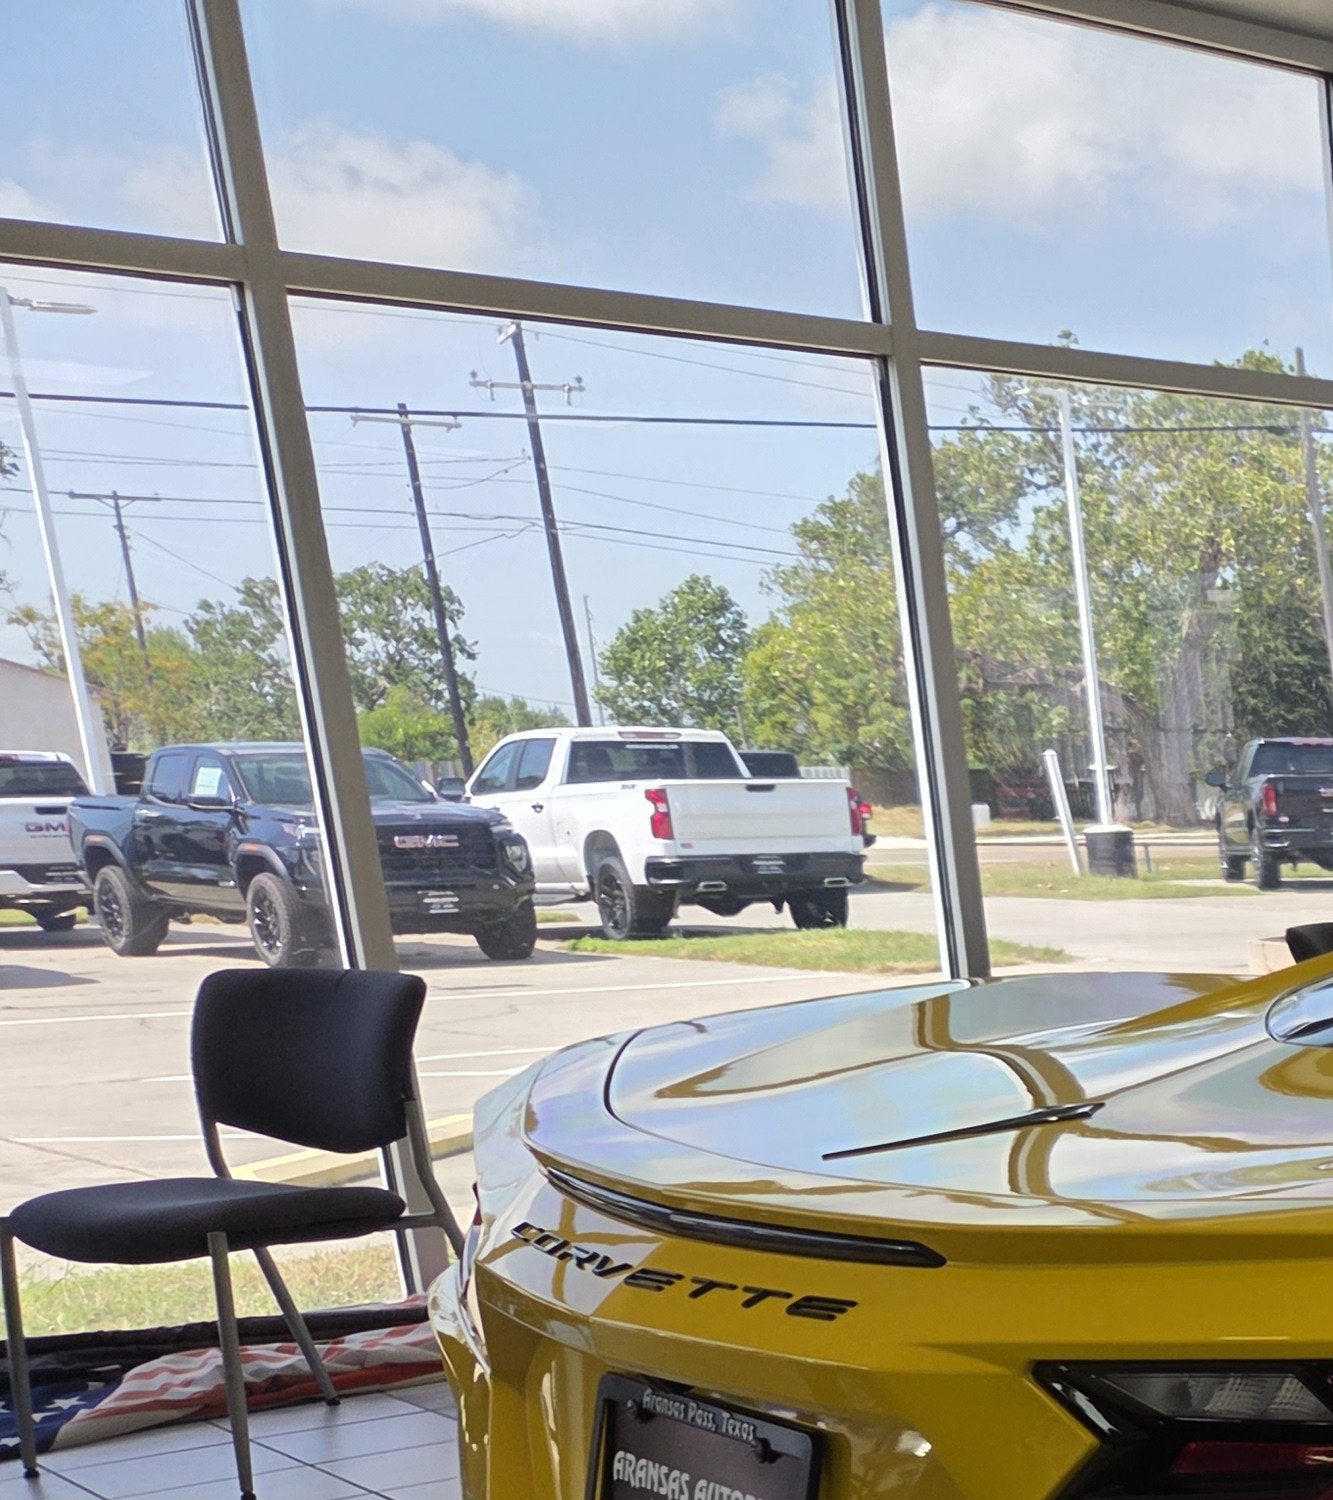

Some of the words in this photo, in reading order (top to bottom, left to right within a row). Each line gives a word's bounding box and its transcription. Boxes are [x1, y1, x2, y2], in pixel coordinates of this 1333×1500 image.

[25, 822, 71, 832] GM
[393, 834, 459, 849] GMC
[510, 1221, 859, 1321] CORVETTE
[642, 1387, 686, 1420] Aransas
